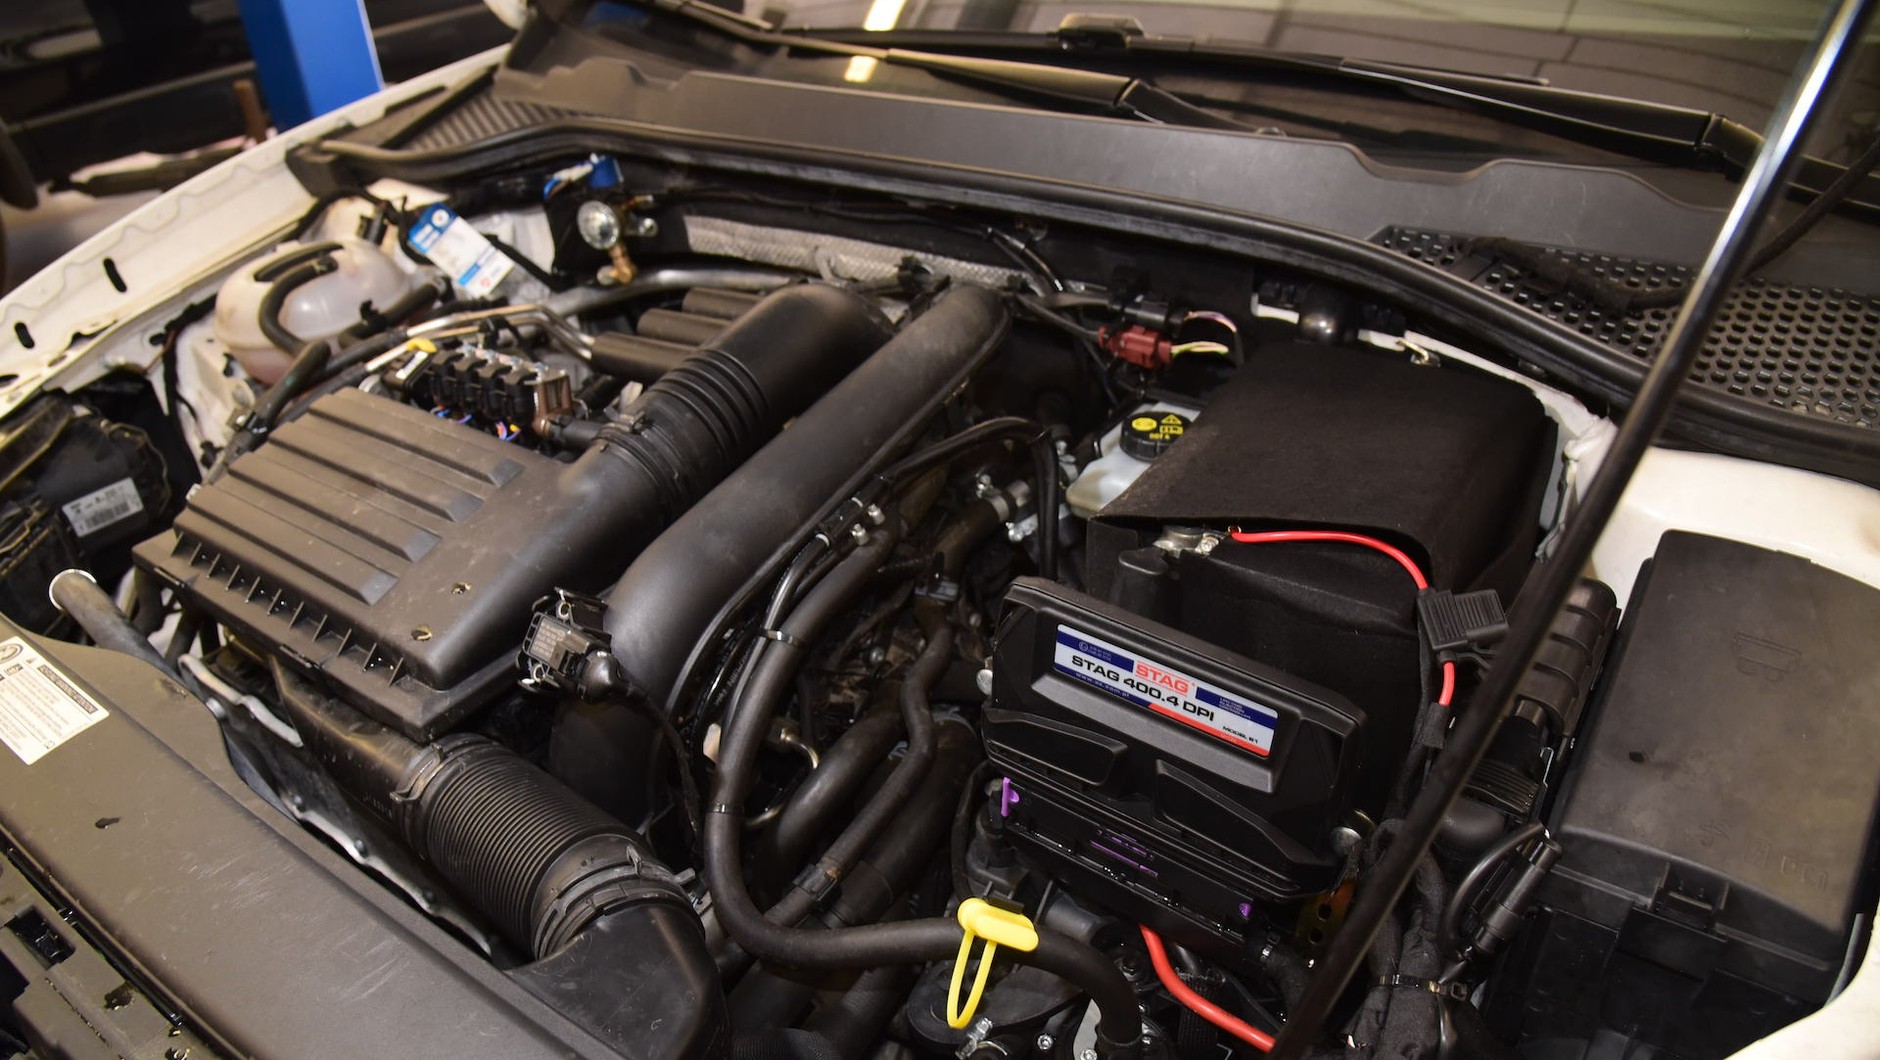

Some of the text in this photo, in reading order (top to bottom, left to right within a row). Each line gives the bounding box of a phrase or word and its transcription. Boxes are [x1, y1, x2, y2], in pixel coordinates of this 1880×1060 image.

[1071, 655, 1119, 681] STAG
[1123, 676, 1179, 707] 400.4
[1182, 701, 1214, 721] DPI
[1136, 662, 1188, 693] STAG
[1222, 725, 1248, 739] MODEL
